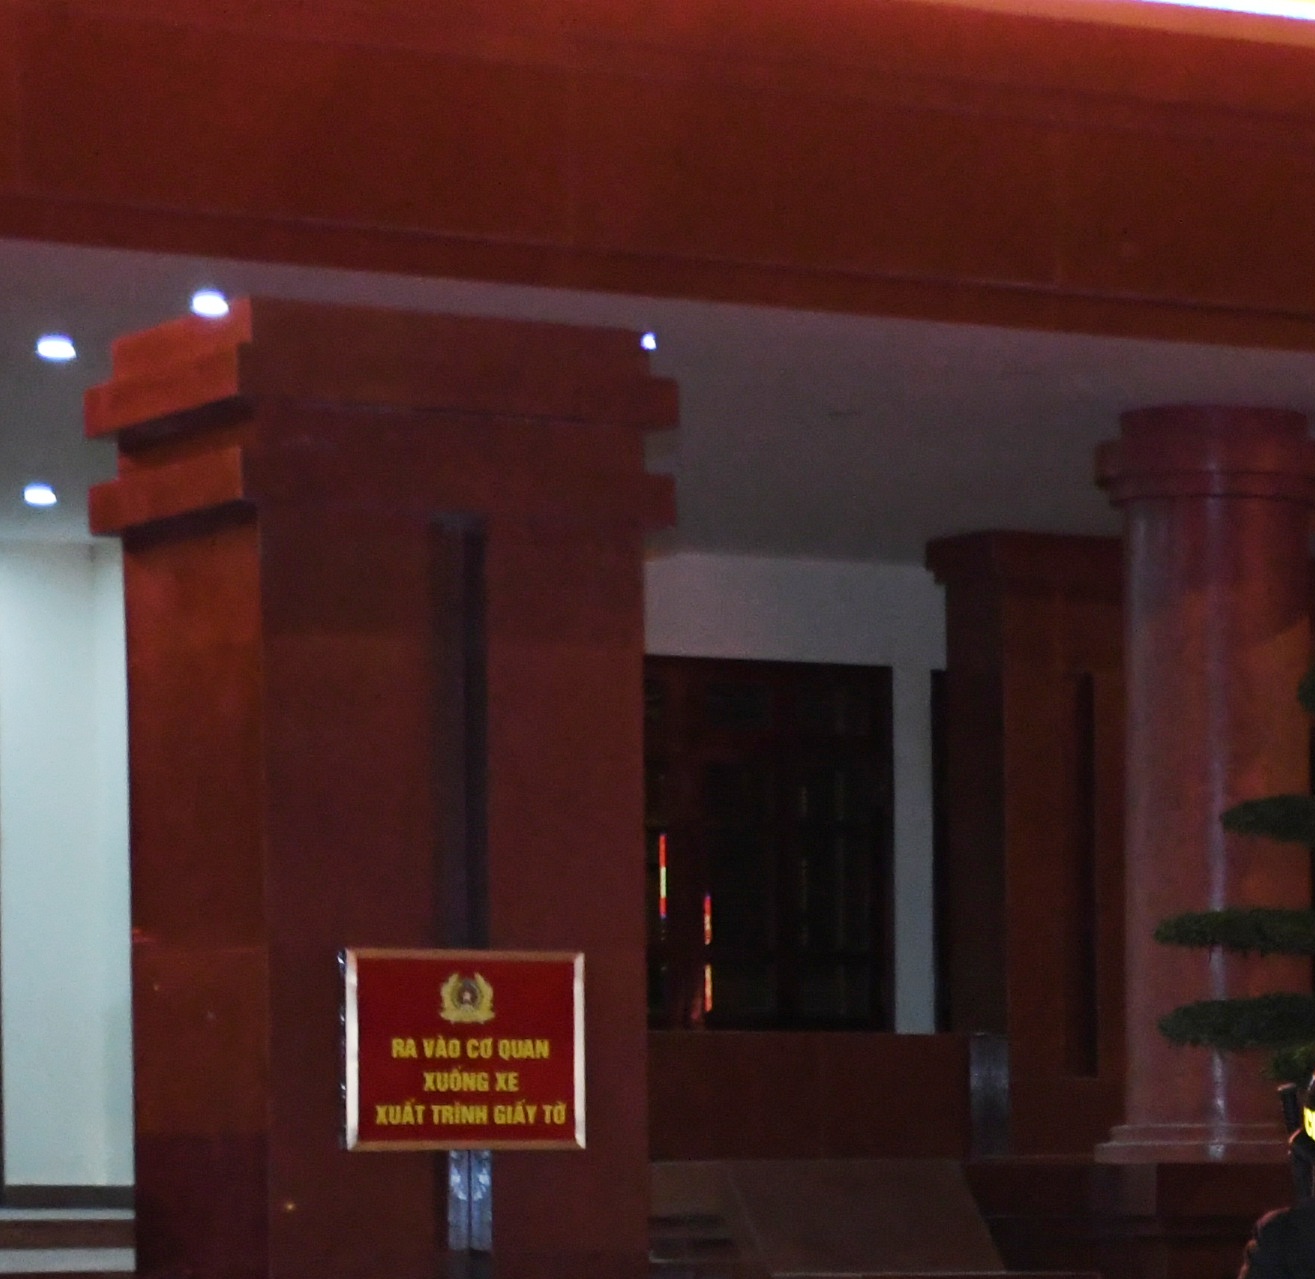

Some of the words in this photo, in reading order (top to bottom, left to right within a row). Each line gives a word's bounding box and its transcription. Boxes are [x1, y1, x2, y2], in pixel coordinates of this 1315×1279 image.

[391, 1037, 418, 1059] RA
[422, 1035, 461, 1059] VÀO
[466, 1038, 493, 1059] CƠ
[498, 1038, 550, 1061] QUAN
[422, 1065, 490, 1092] XUỐNG
[495, 1071, 520, 1092] XE
[375, 1098, 426, 1125] XUẤT
[431, 1101, 489, 1125] TRÌNH
[493, 1098, 538, 1125] GIẤY
[542, 1101, 567, 1125] TỜ
